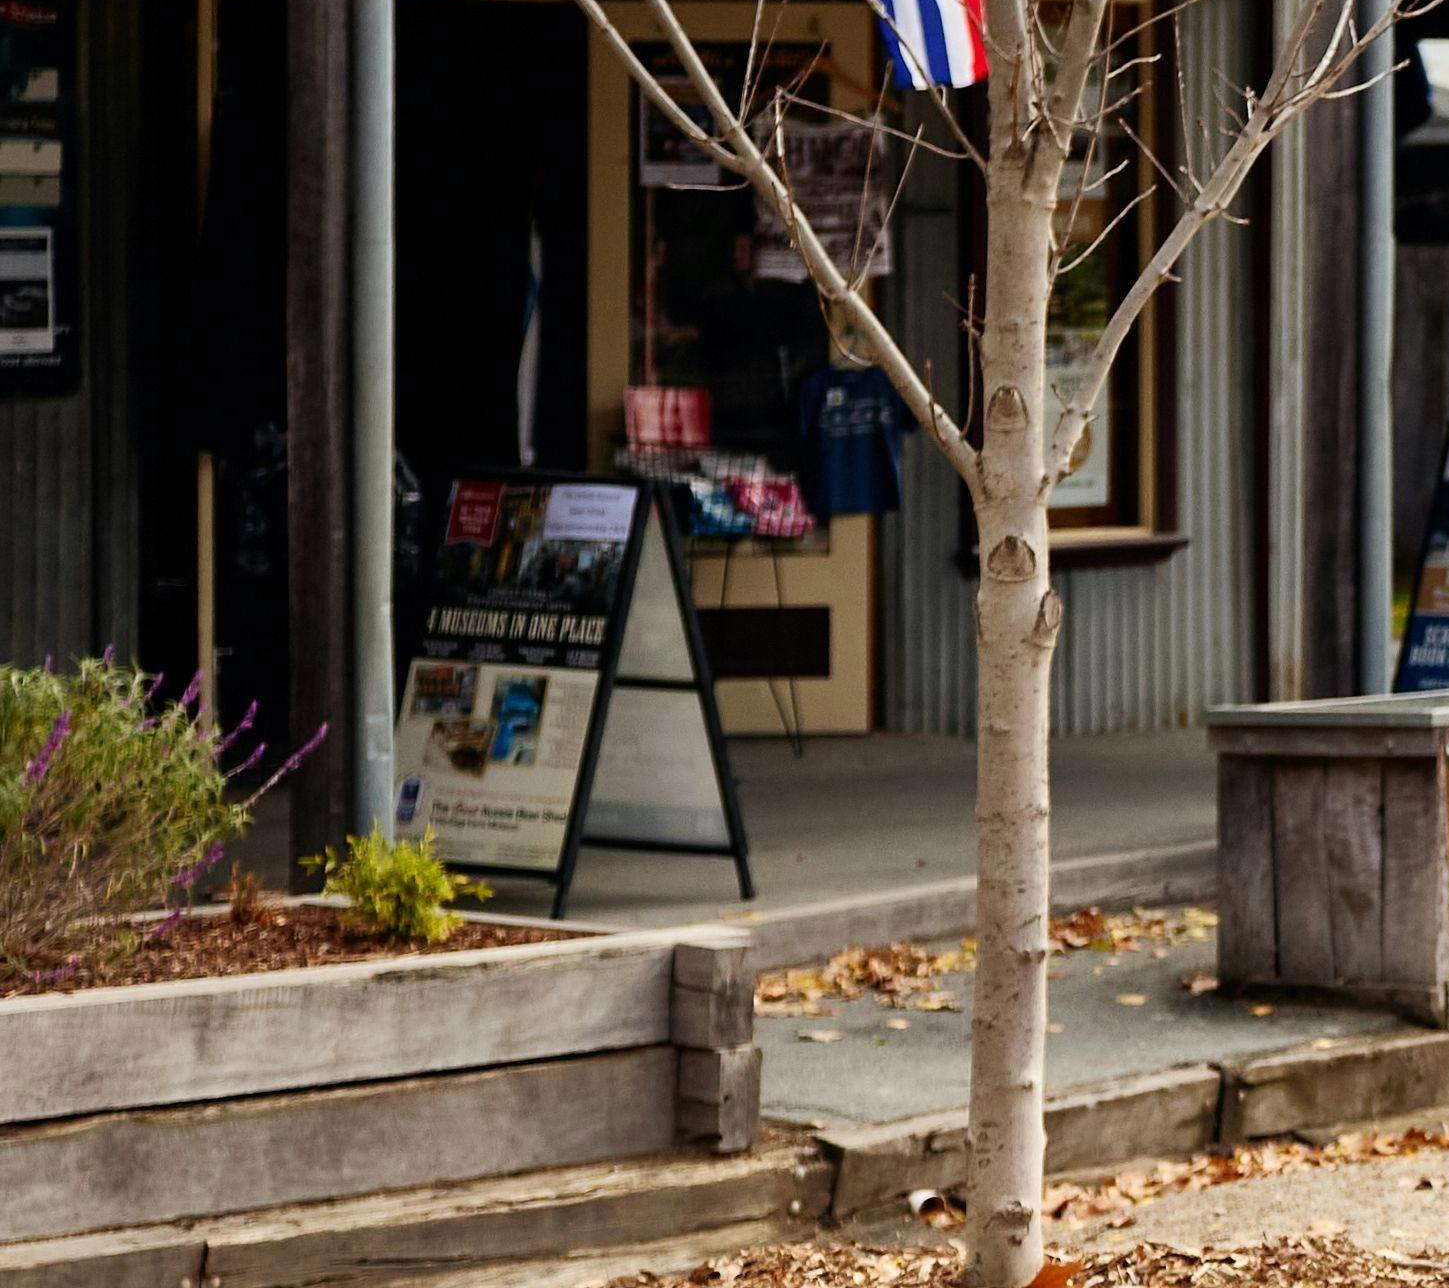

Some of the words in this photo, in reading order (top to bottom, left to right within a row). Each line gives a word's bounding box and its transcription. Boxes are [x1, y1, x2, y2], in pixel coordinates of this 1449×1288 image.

[438, 607, 509, 638] MUSEUMS
[509, 611, 529, 640] IN
[528, 612, 560, 643] ONE
[559, 614, 607, 646] PLACE
